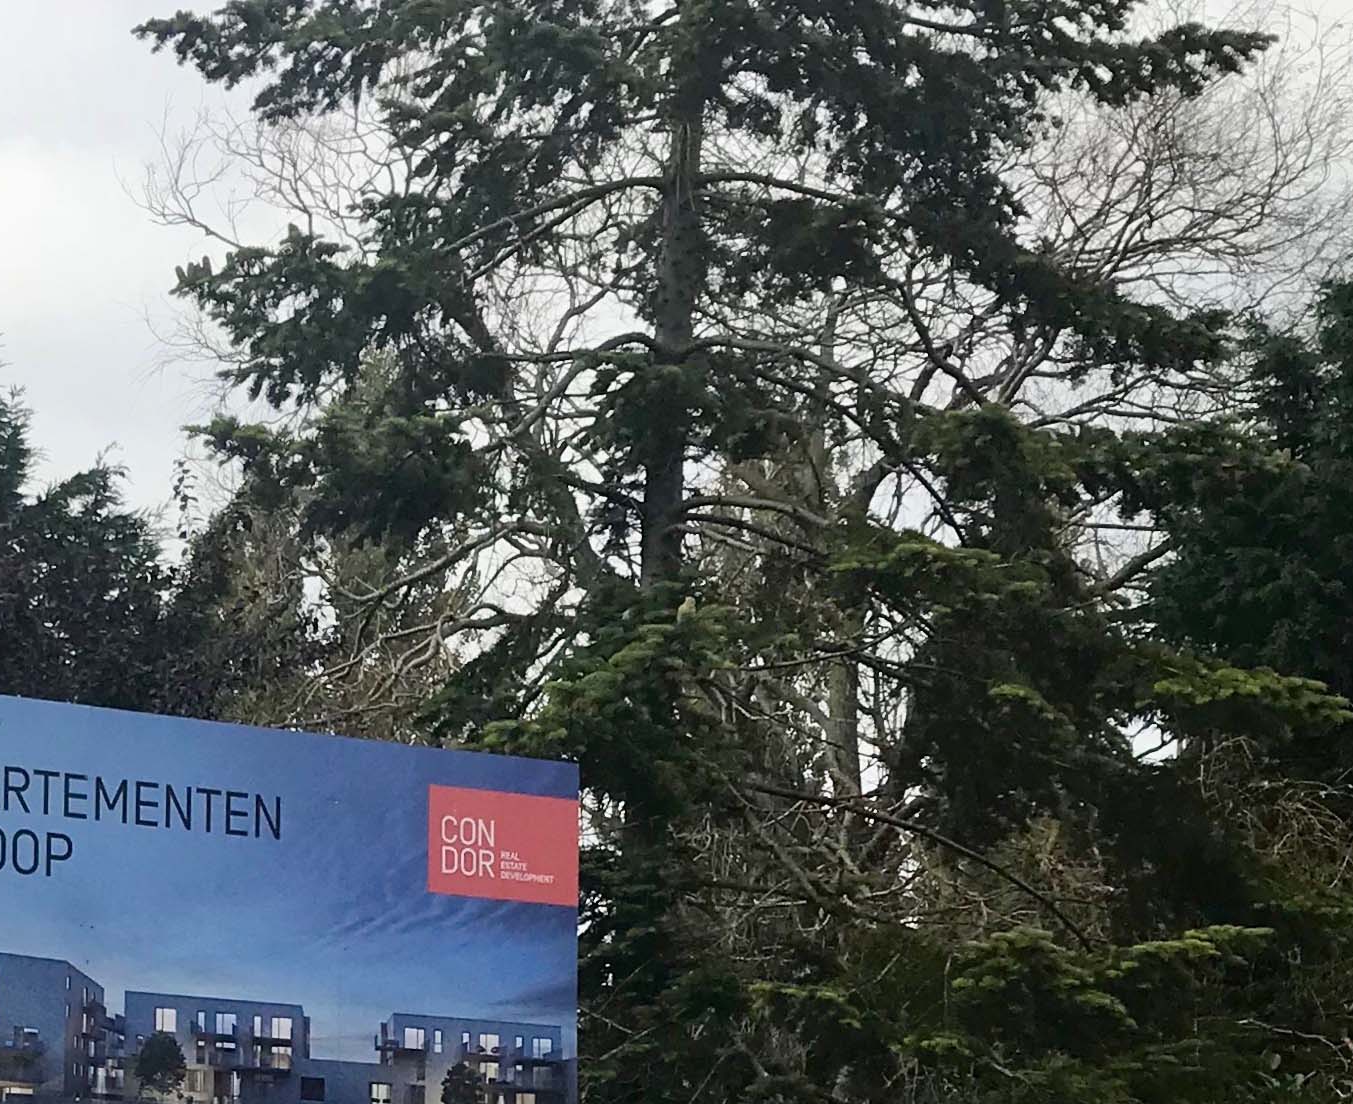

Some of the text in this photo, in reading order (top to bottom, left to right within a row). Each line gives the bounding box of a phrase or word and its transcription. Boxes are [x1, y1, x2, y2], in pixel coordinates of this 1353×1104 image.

[441, 815, 496, 848] CON
[441, 846, 496, 878] DOR
[500, 850, 520, 862] REAL
[500, 861, 528, 871] ESTATE
[500, 870, 555, 884] DEVELOPMENT
